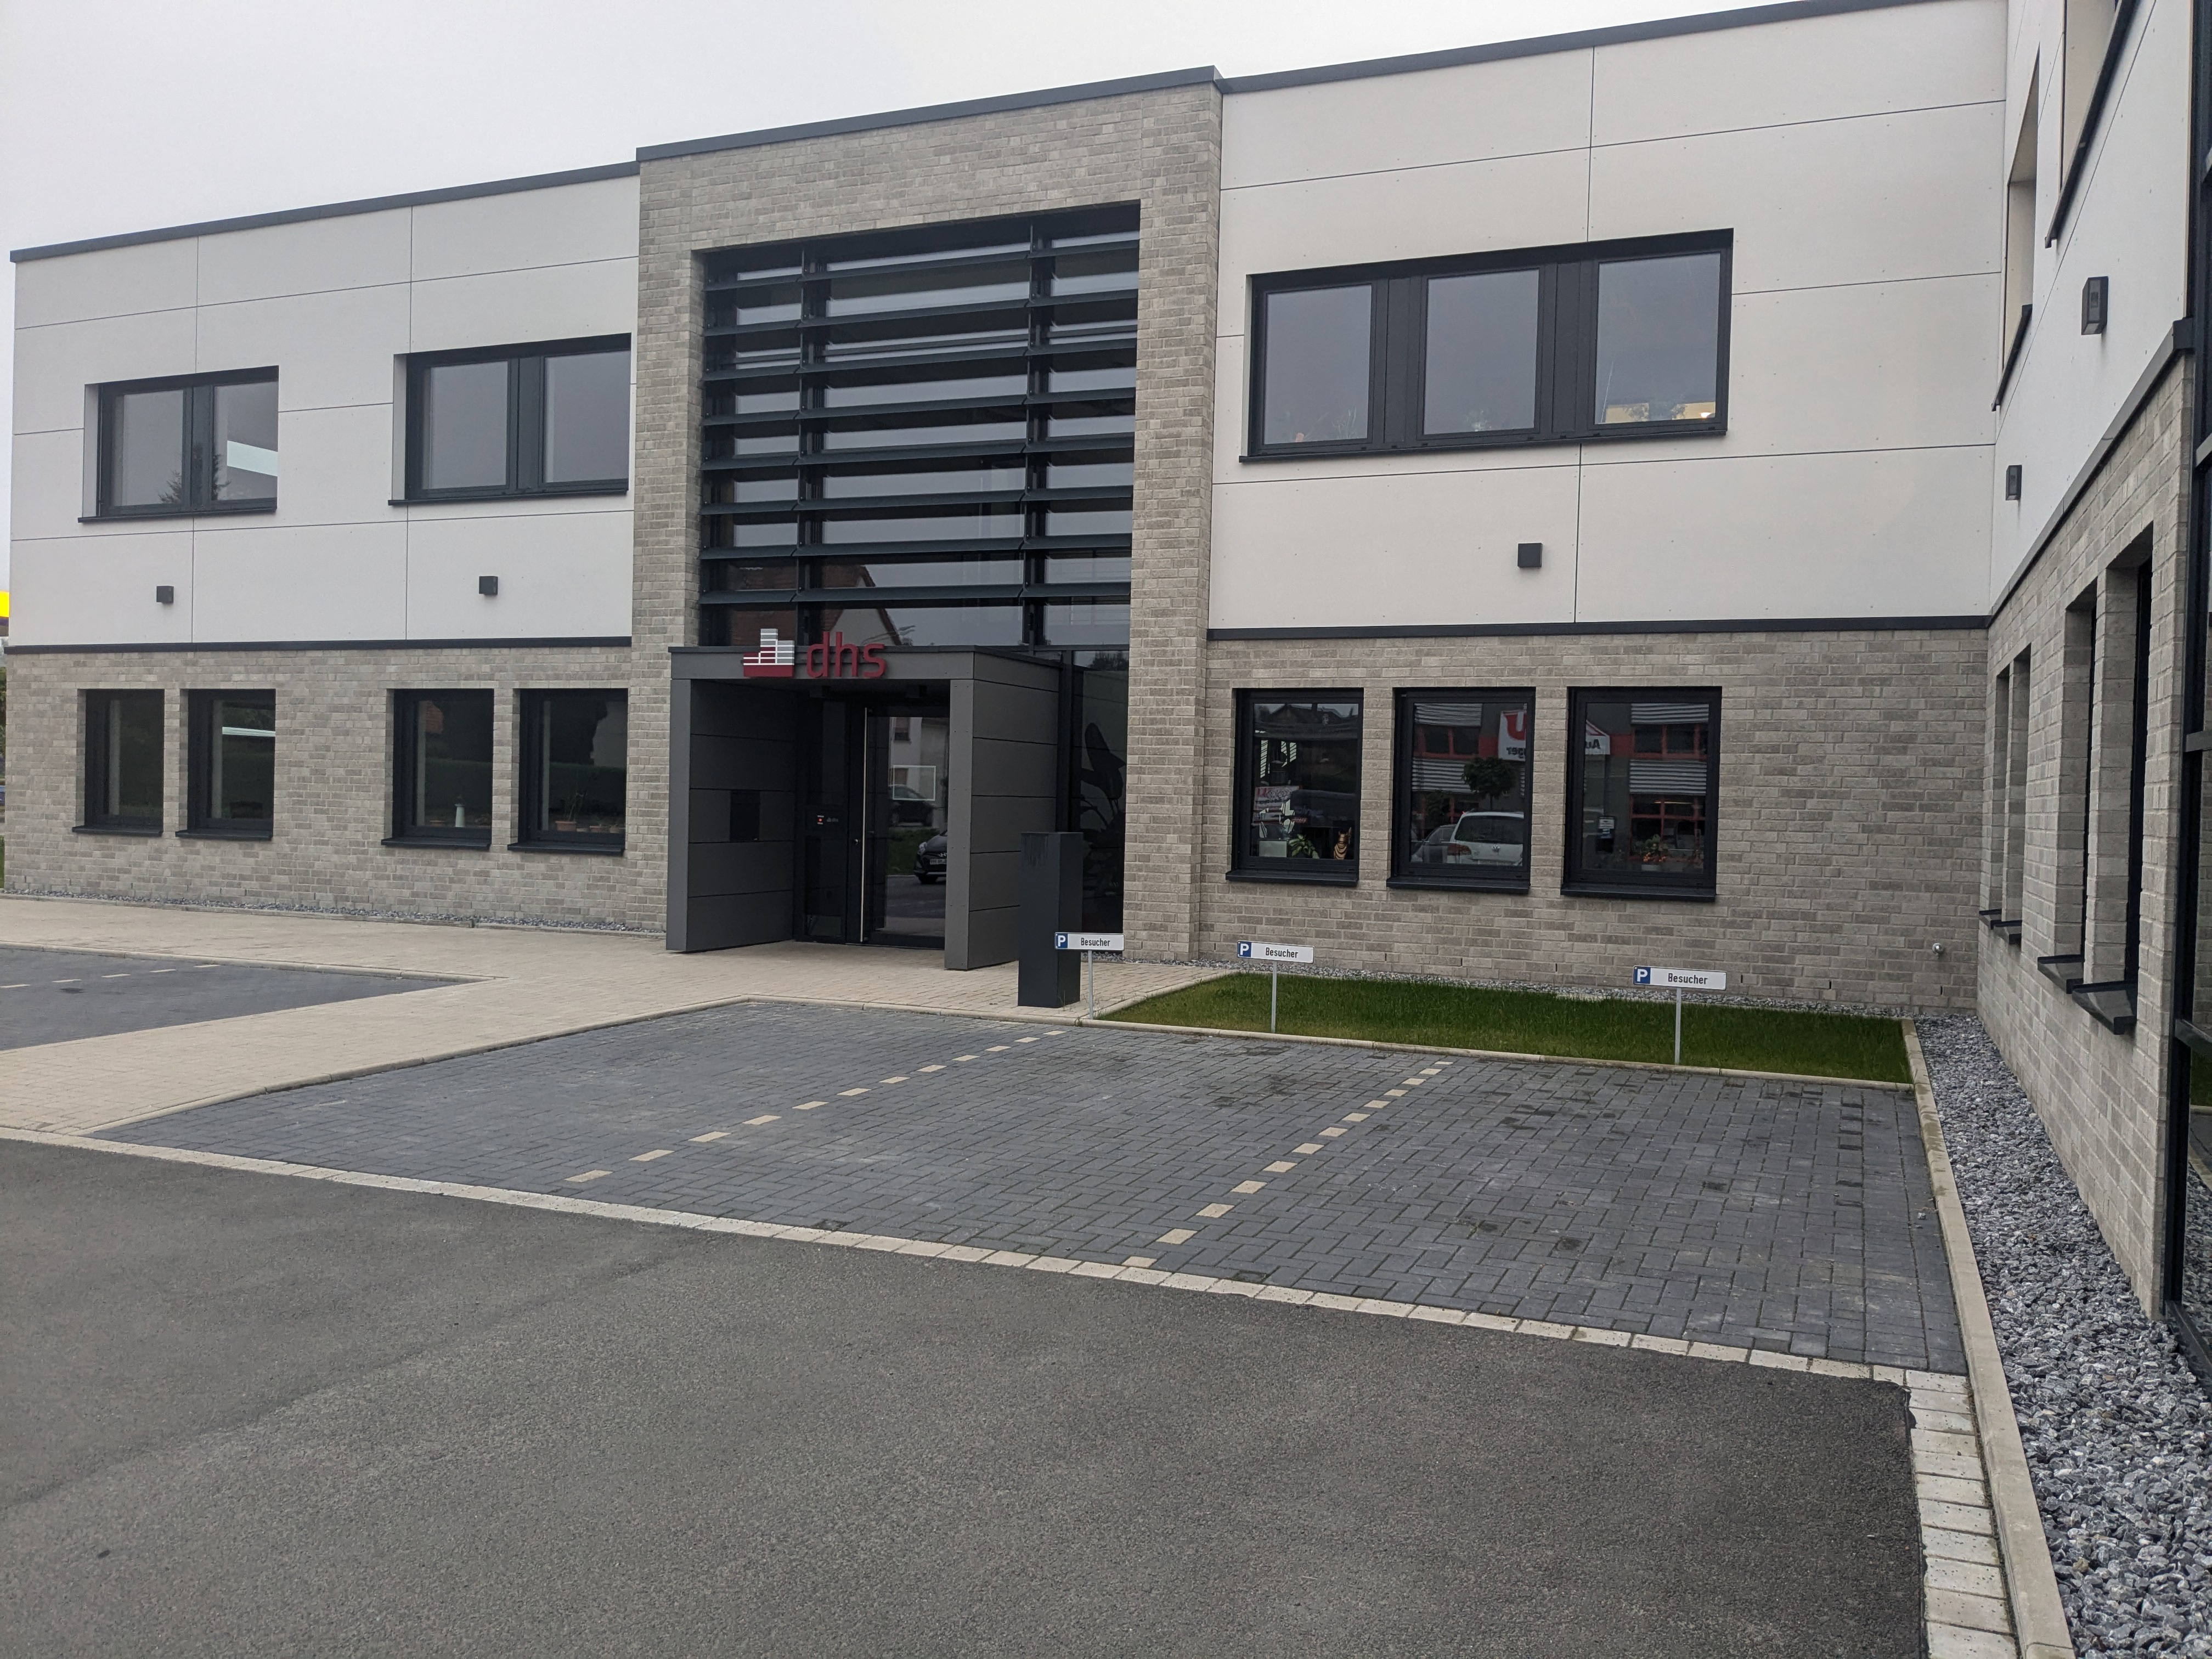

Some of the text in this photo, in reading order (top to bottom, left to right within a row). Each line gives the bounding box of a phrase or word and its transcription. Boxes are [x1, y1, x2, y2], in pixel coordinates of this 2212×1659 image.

[806, 631, 887, 679] dhs
[1058, 935, 1111, 947] P Besucher
[1240, 943, 1299, 958] P Besucher
[1637, 968, 1708, 985] P Besucher
